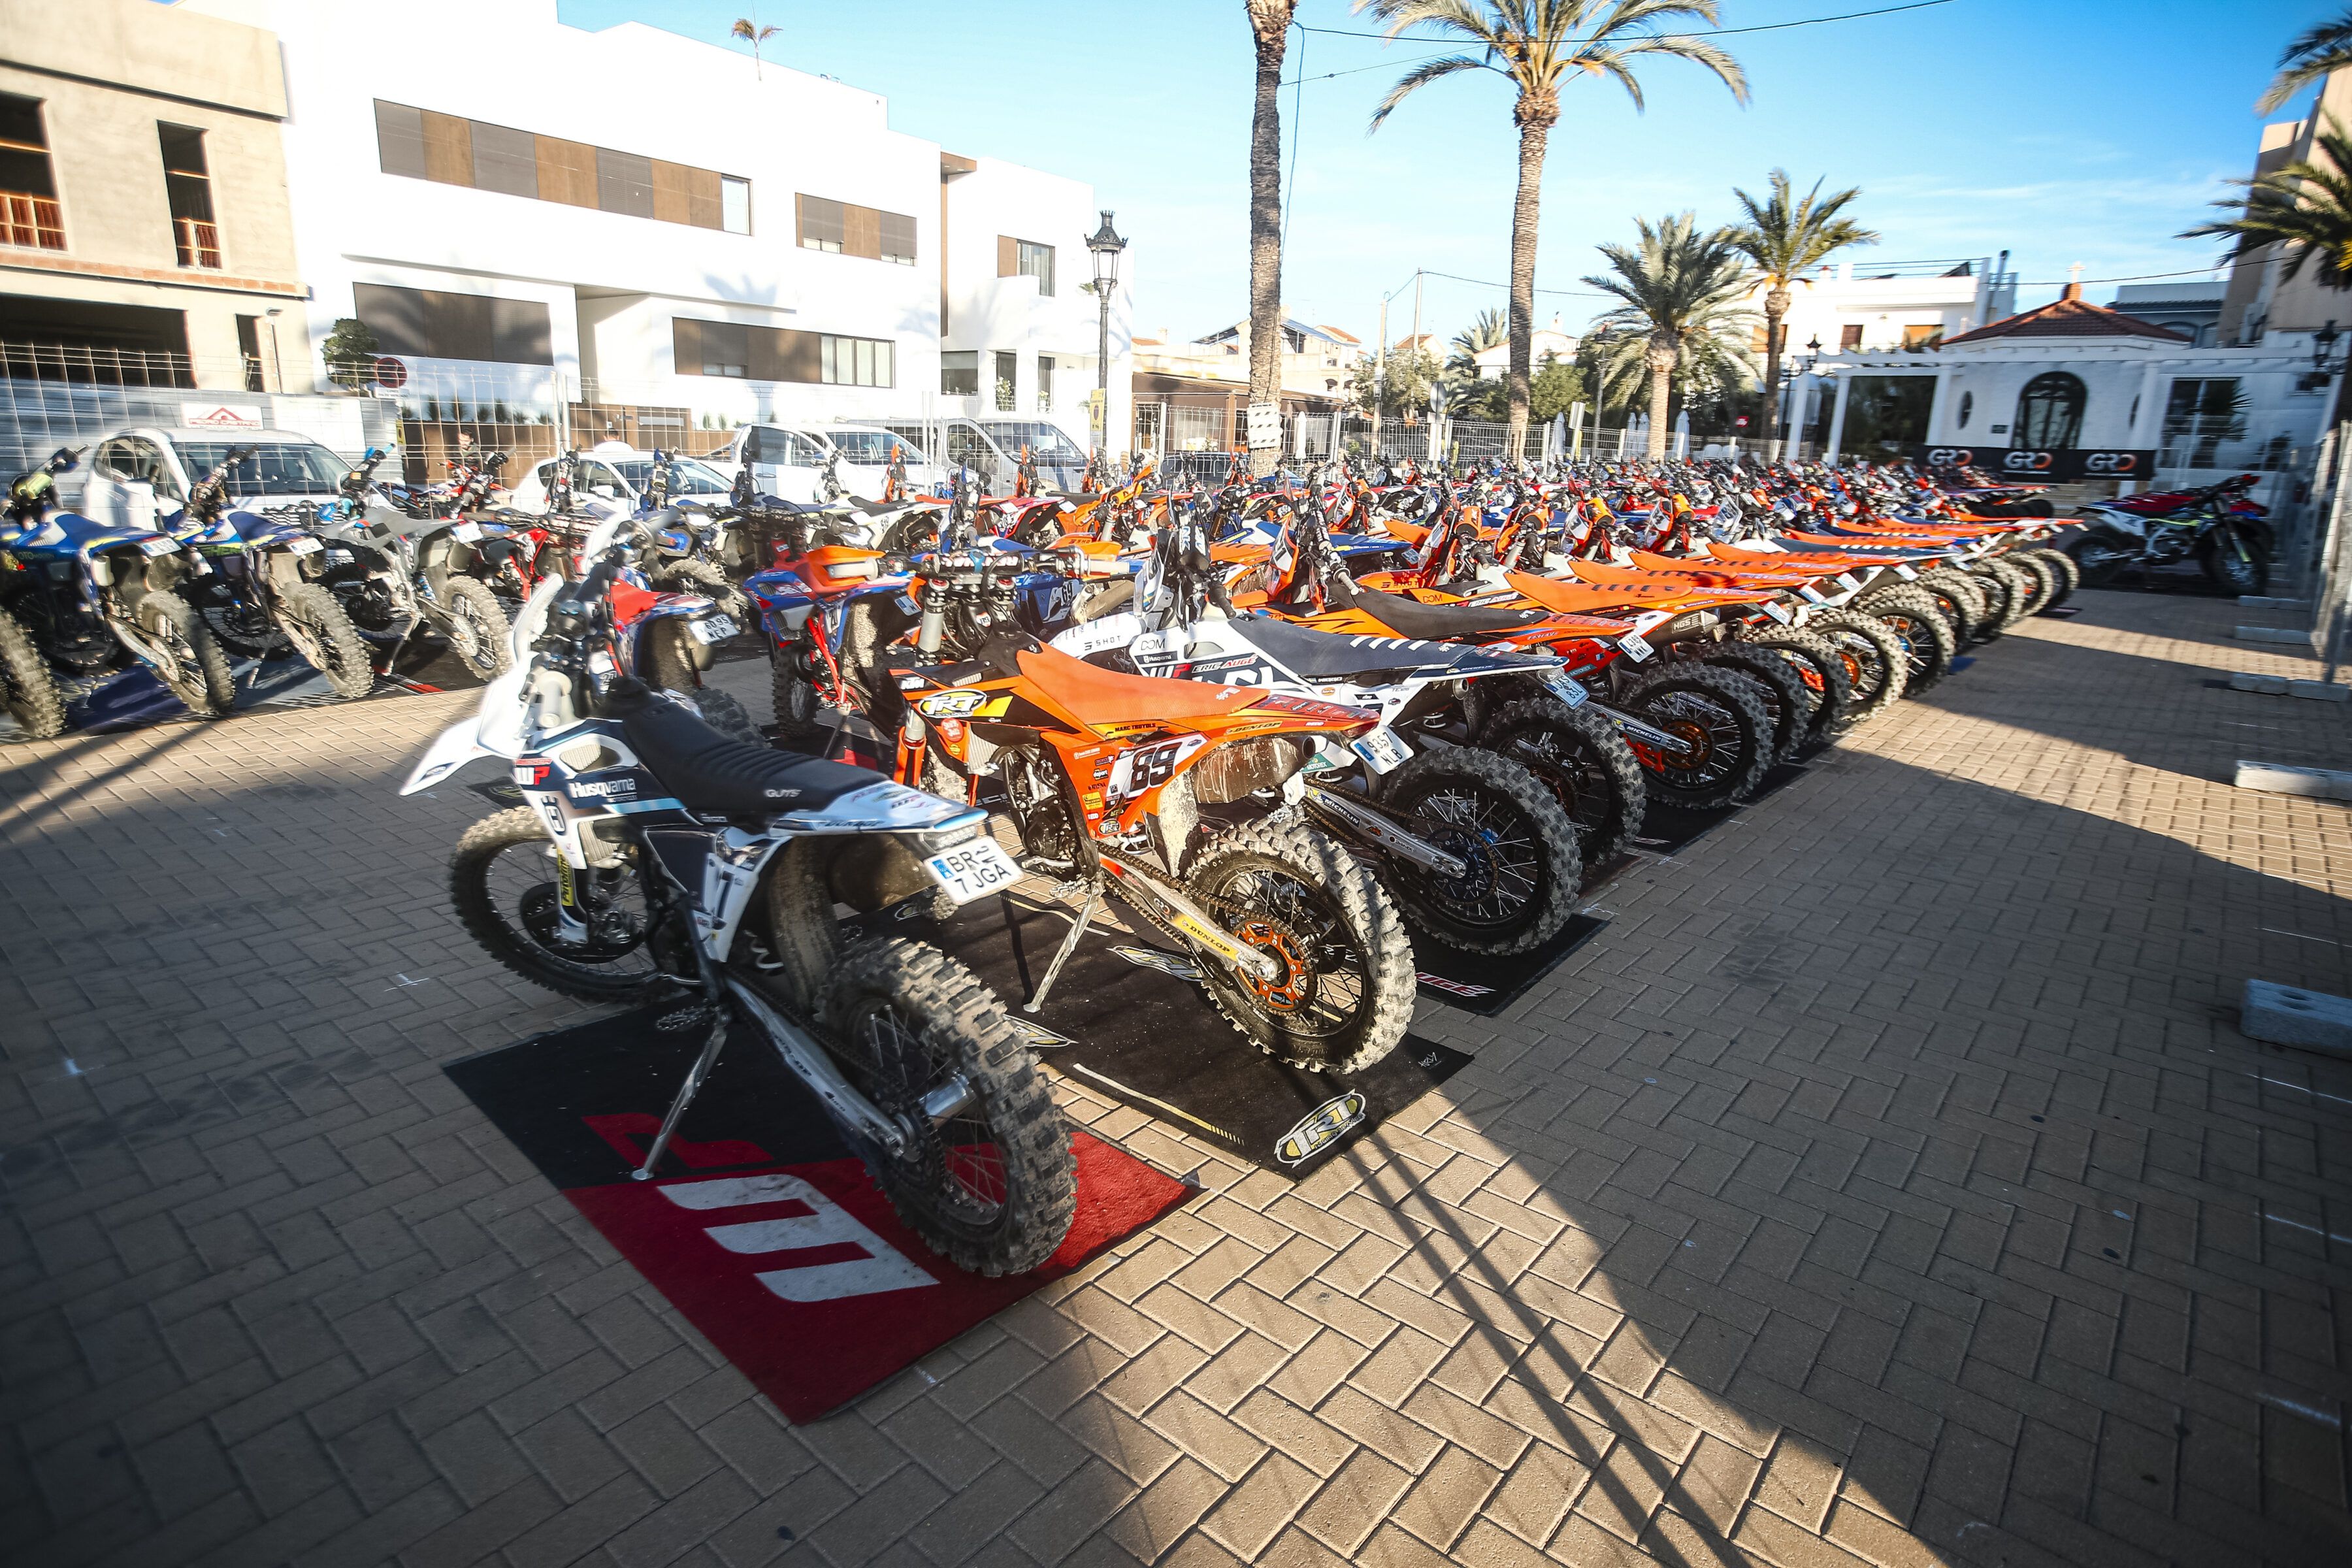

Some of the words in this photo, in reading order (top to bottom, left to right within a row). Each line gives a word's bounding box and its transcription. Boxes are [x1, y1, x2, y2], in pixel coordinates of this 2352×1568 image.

[1929, 449, 1972, 466] GRO
[2004, 452, 2052, 470] GRO
[2085, 453, 2136, 471] GRO
[1061, 582, 1073, 602] 69
[708, 628, 727, 640] NEP
[1674, 620, 1691, 630] HGS
[1096, 635, 1121, 646] SHOT
[1192, 662, 1220, 673] ERIC
[1219, 653, 1258, 670] AUGÉ
[1569, 665, 1593, 677] MOTOREX
[901, 677, 926, 690] KTM
[1556, 675, 1571, 689] JAS
[1566, 687, 1583, 700] 83L
[923, 695, 982, 716] TRT
[1233, 721, 1281, 733] DUNLOP
[1626, 726, 1661, 741] MICHELIN
[1367, 732, 1394, 753] 9357
[1130, 741, 1183, 792] 89
[1307, 761, 1327, 770] MOTOREX
[1380, 749, 1403, 766] NLB
[514, 766, 550, 785] WP
[568, 777, 636, 798] Husqvarna
[764, 789, 802, 798] GUTS
[1324, 798, 1360, 825] MICHELIN
[947, 851, 979, 872] BR
[955, 878, 970, 894] 7
[973, 863, 1012, 889] JGA
[1188, 925, 1230, 953] DUNLOP
[1279, 1094, 1353, 1158] TRT
[1315, 1132, 1336, 1150] racing
